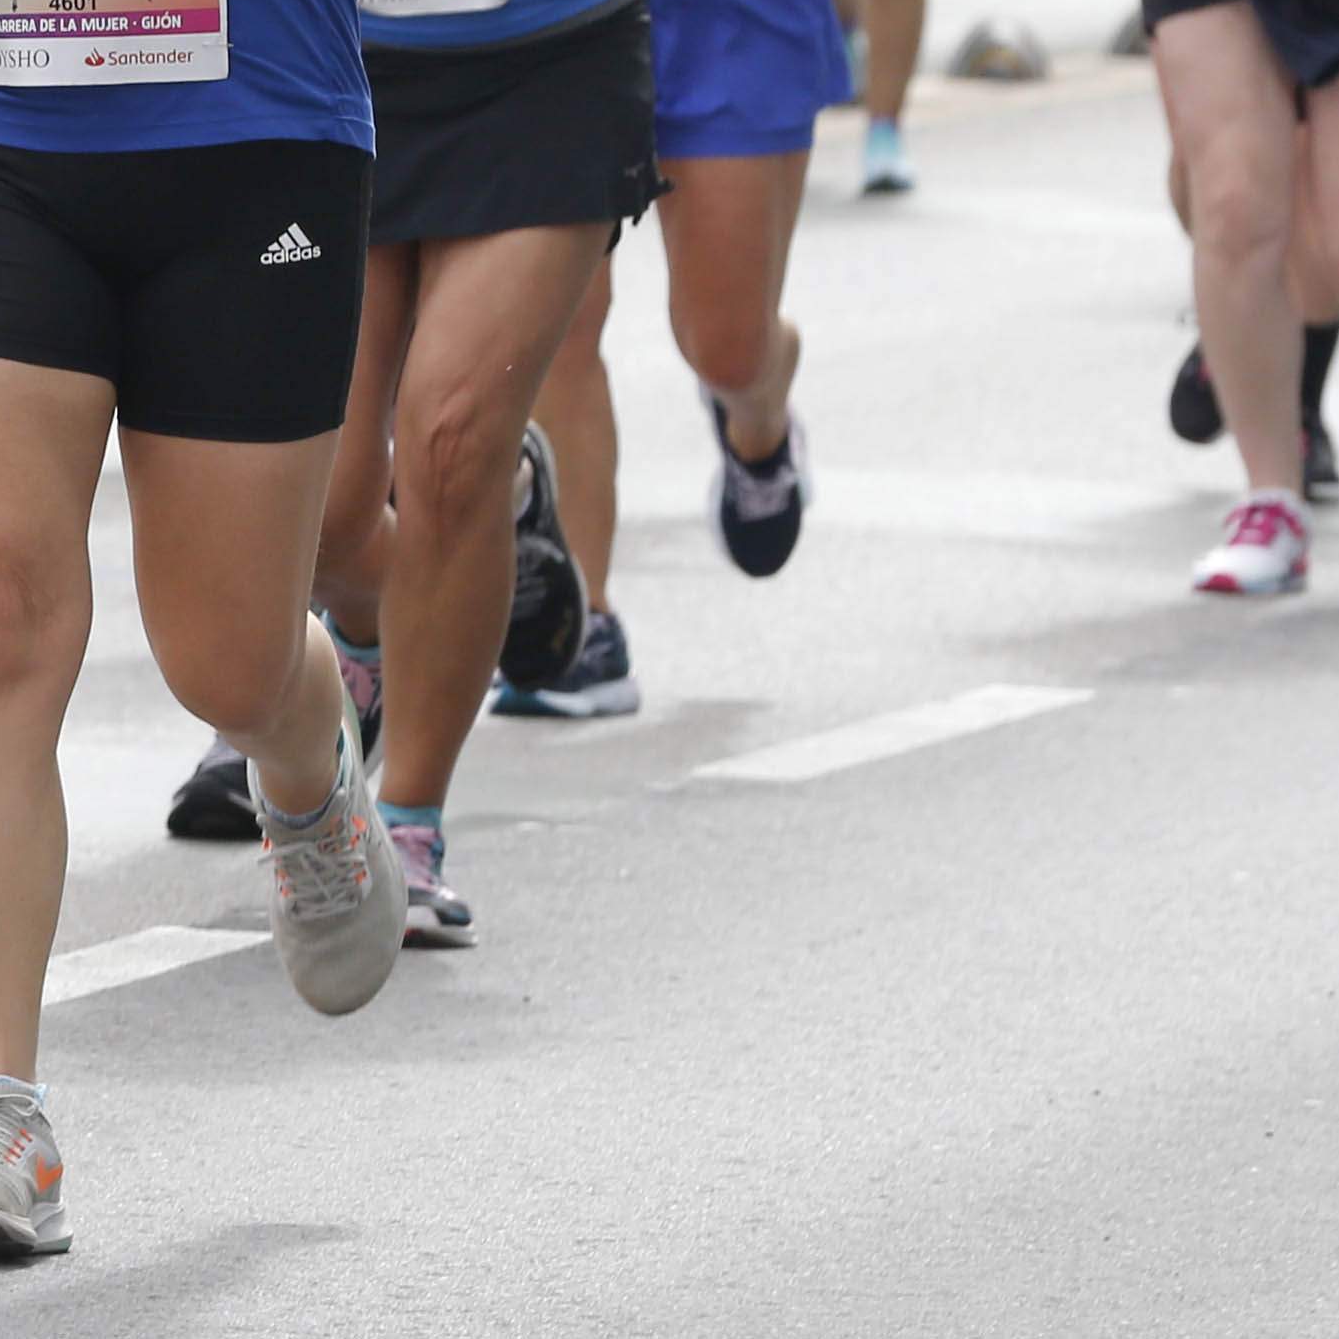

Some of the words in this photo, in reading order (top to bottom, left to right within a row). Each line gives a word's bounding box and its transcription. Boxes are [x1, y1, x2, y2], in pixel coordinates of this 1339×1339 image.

[39, 18, 56, 32] DE
[60, 17, 77, 32] LA
[81, 14, 129, 31] MUJER
[141, 11, 182, 29] GIJÓN
[108, 49, 194, 66] Santander
[260, 246, 321, 264] adidas
